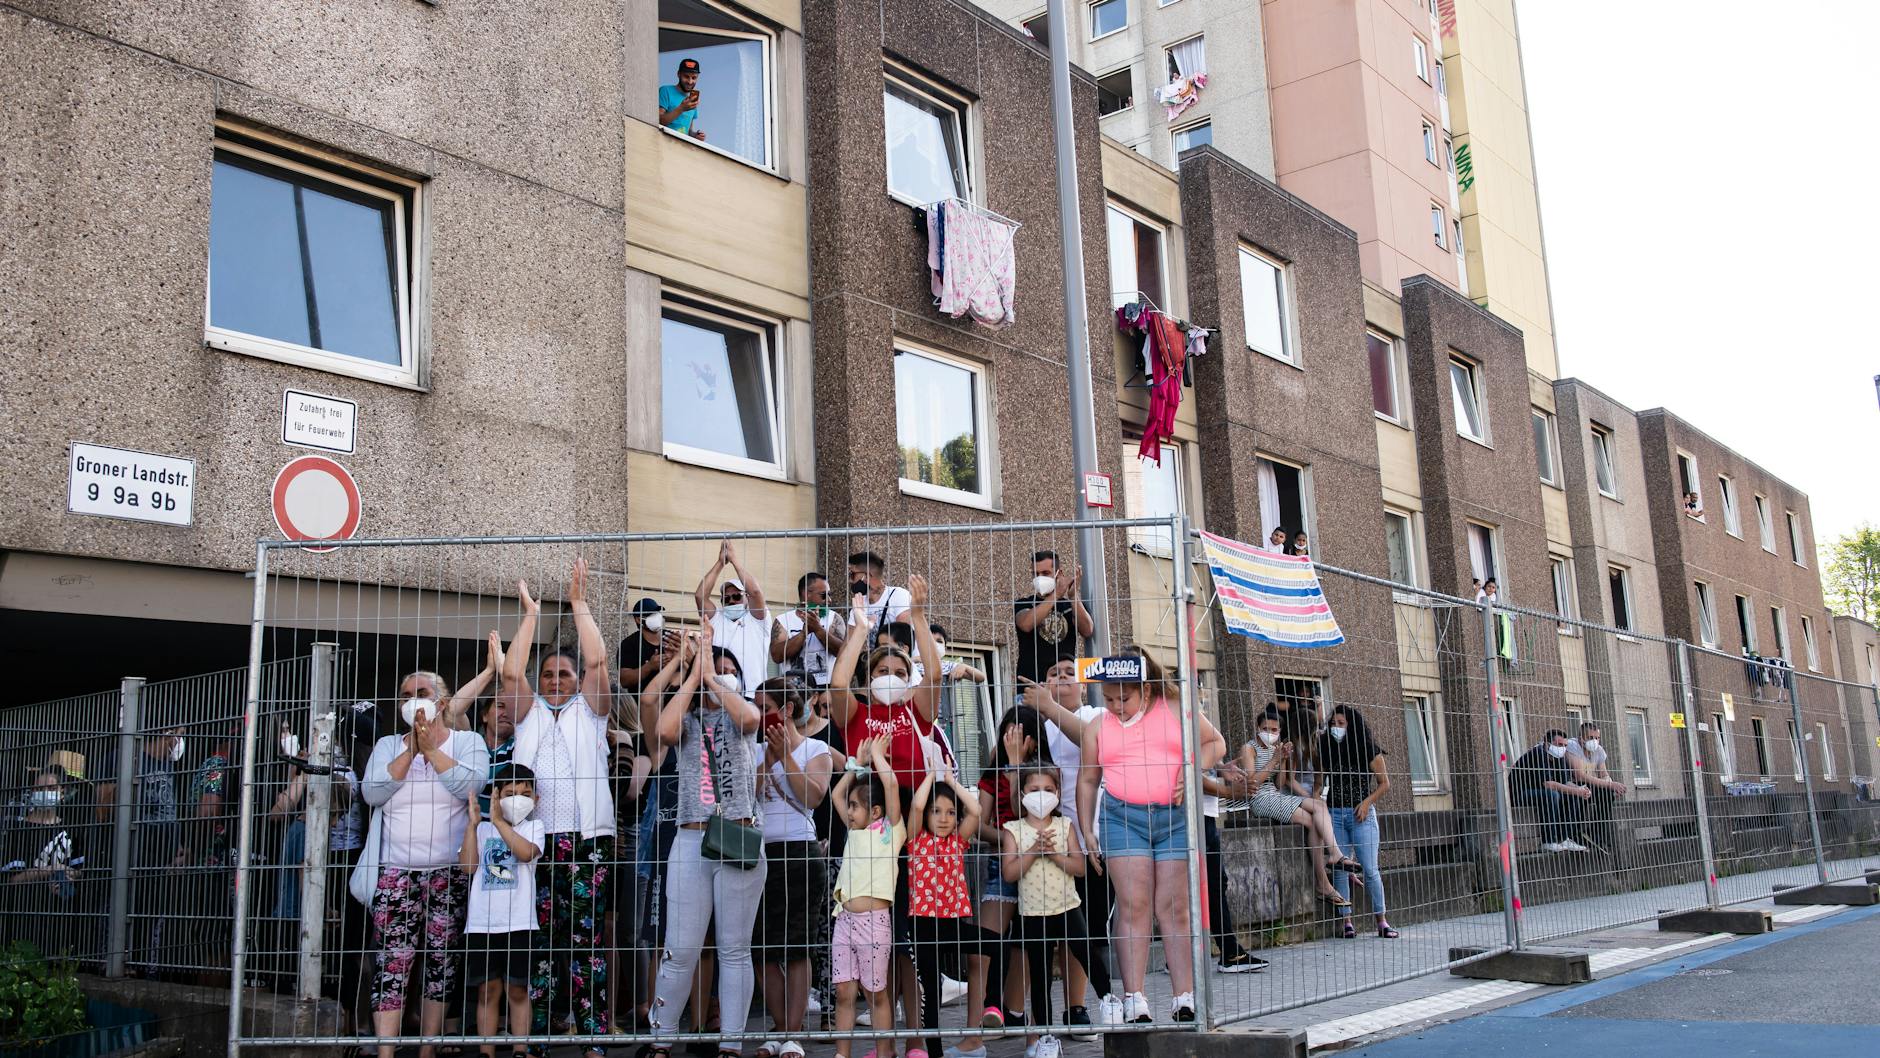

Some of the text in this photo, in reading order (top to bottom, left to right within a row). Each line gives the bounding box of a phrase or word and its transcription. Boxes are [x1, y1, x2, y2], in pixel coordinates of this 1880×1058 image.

[330, 408, 342, 418] frei
[294, 421, 346, 438] für Feuerwehr
[77, 456, 189, 487] Groner Landstr.
[88, 483, 176, 512] 9 9a 9b
[1083, 657, 1105, 679] HKL
